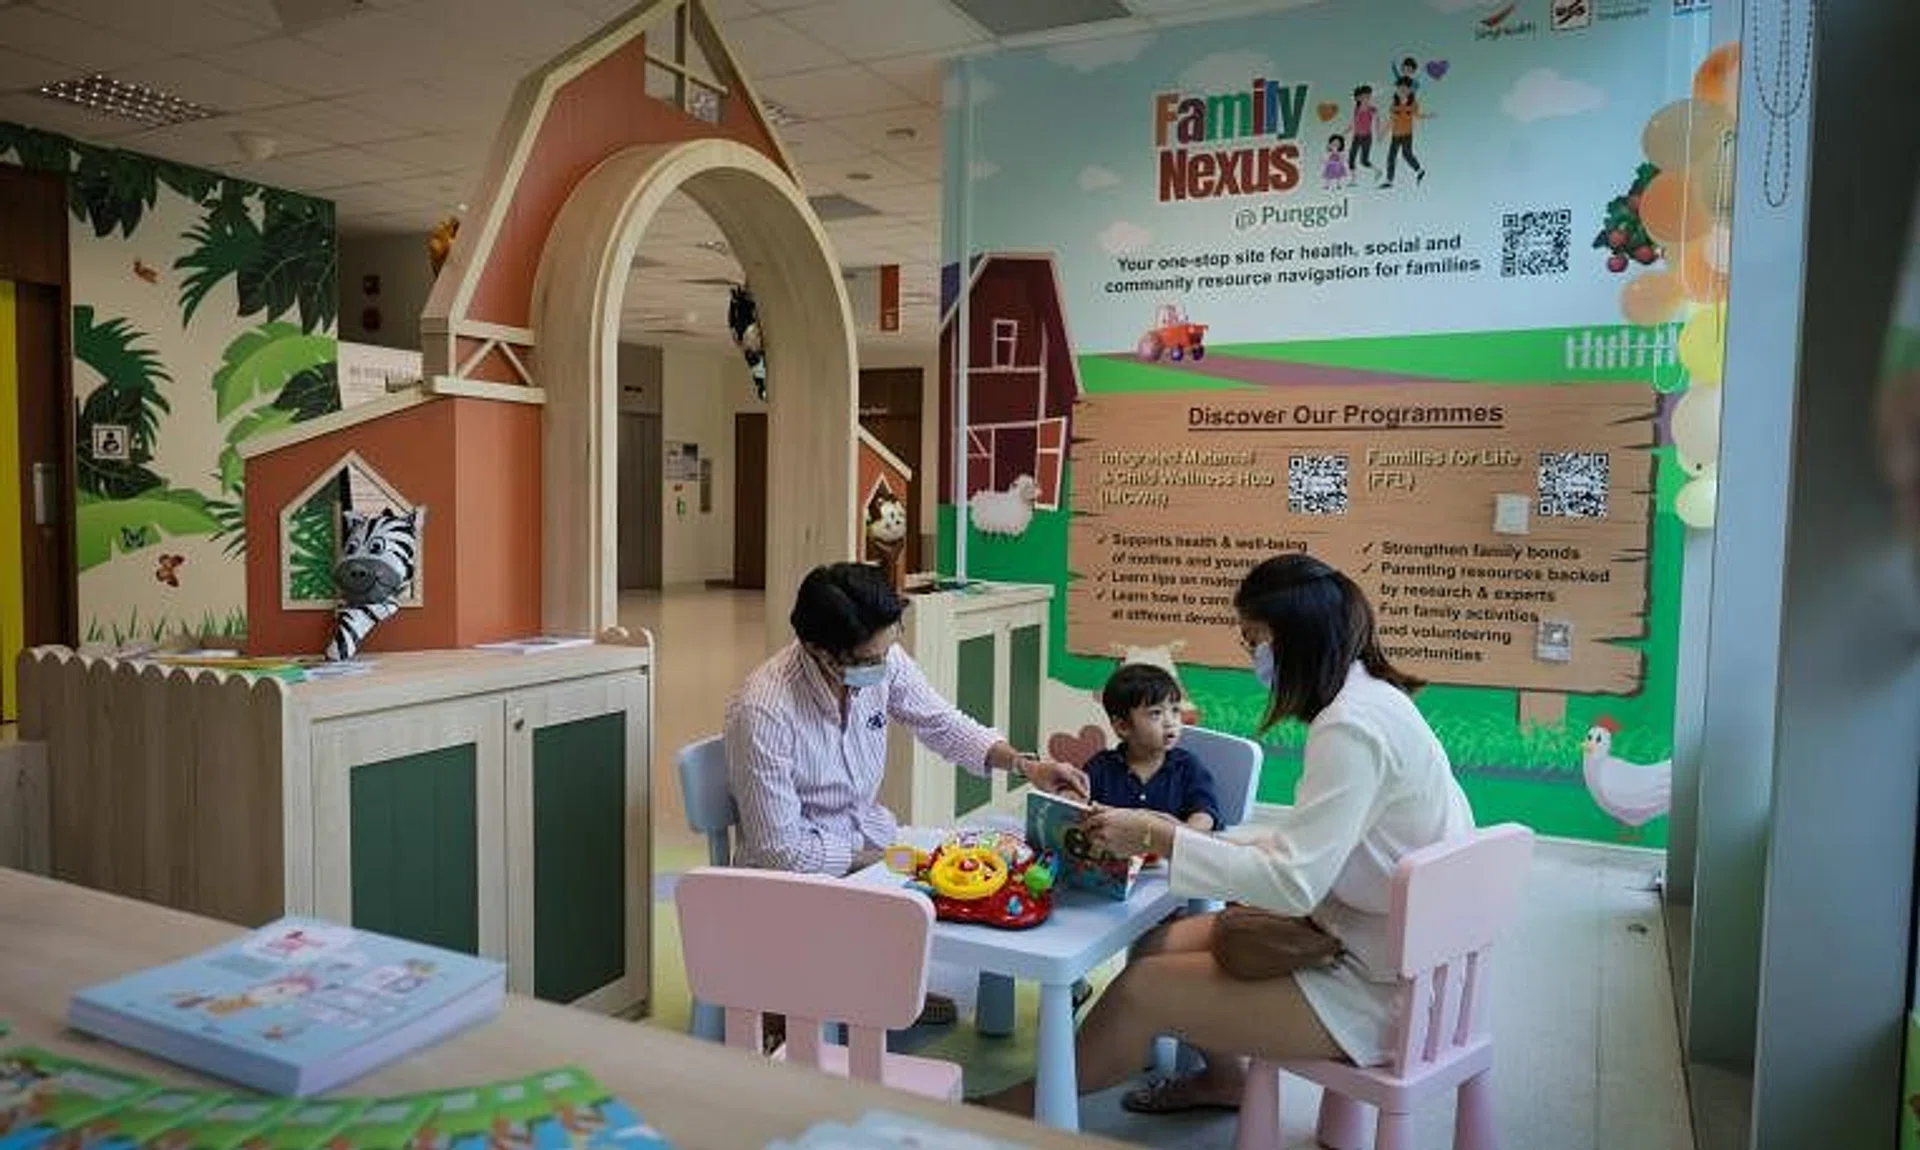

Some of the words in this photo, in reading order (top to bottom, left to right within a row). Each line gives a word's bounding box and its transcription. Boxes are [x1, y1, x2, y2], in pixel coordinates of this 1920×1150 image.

[1156, 78, 1308, 147] Family
[1160, 144, 1300, 202] Nexus
[1235, 208, 1257, 229] @
[1262, 198, 1348, 228] Punggol
[1117, 257, 1153, 272] Your
[1157, 252, 1230, 269] one-stop
[1235, 248, 1265, 264] site
[1270, 246, 1295, 262] for
[1364, 235, 1421, 255] social
[1426, 234, 1462, 251] and
[1104, 276, 1194, 293] community
[1198, 273, 1272, 288] resource
[1278, 264, 1370, 285] navigation
[1375, 262, 1400, 277] for
[1406, 256, 1481, 275] families
[1188, 406, 1287, 426] Discover
[1292, 405, 1338, 425] Our
[1343, 404, 1505, 428] Programmes
[1101, 449, 1182, 468] Integrated
[1366, 448, 1446, 467] Families
[1450, 448, 1479, 466] for
[1482, 448, 1521, 466] Life
[1162, 471, 1234, 487] Wellness
[1111, 534, 1172, 550] Supports
[1175, 535, 1218, 548] health
[1221, 535, 1232, 549] &
[1235, 536, 1308, 552] well-being
[1381, 541, 1469, 558] Strengthen
[1472, 543, 1522, 561] family
[1527, 545, 1581, 560] bonds
[1112, 552, 1126, 564] of
[1128, 553, 1182, 566] mothers
[1185, 554, 1211, 568] and
[1112, 571, 1149, 584] Learn
[1381, 561, 1457, 579] Parenting
[1460, 565, 1542, 581] resources
[1547, 568, 1611, 583] backed
[1112, 589, 1149, 602] Learn
[1151, 590, 1179, 604] how
[1182, 593, 1197, 605] to
[1380, 582, 1398, 598] by
[1403, 584, 1473, 599] research
[1476, 586, 1489, 600] &
[1493, 588, 1556, 603] experts
[1126, 609, 1182, 622] different
[1379, 602, 1409, 616] Fun
[1413, 603, 1461, 621] family
[1465, 606, 1540, 624] activities
[1379, 624, 1408, 637] and
[1412, 625, 1512, 645] volunteering
